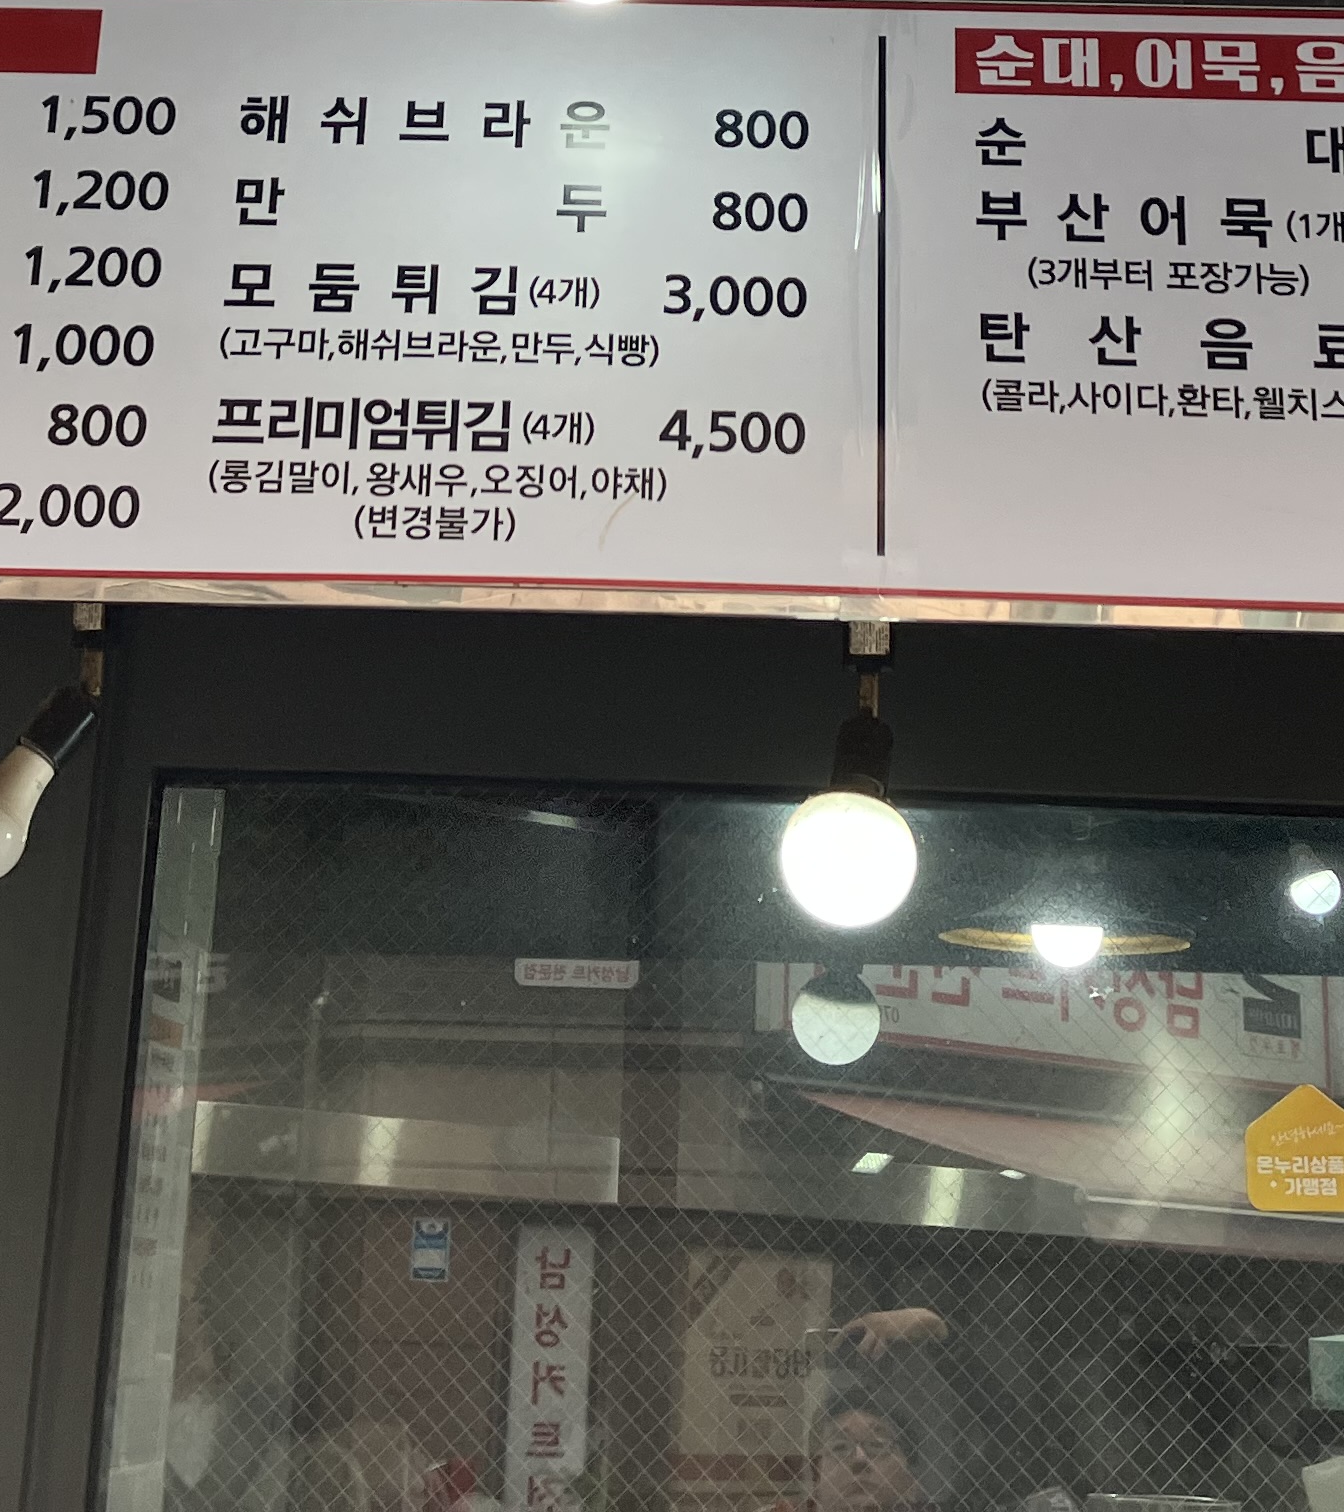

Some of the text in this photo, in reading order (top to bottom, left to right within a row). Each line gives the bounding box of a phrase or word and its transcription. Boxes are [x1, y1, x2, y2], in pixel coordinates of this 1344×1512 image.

[42, 95, 176, 141] 1,500
[714, 109, 809, 150] 800
[34, 169, 169, 216] 1,200
[712, 191, 808, 233] 800
[25, 246, 162, 293] 1,200
[1028, 256, 1309, 296] (3개부터 포장가능)
[529, 276, 600, 309] (4개)
[663, 274, 807, 322] 3,000
[14, 323, 154, 372] 1,000
[47, 404, 147, 447] 800
[212, 396, 805, 459] 프리미엄튀김 (4개) 4,500
[355, 505, 515, 542] (변경불가)
[1284, 1178, 1337, 1196] 가맹점
